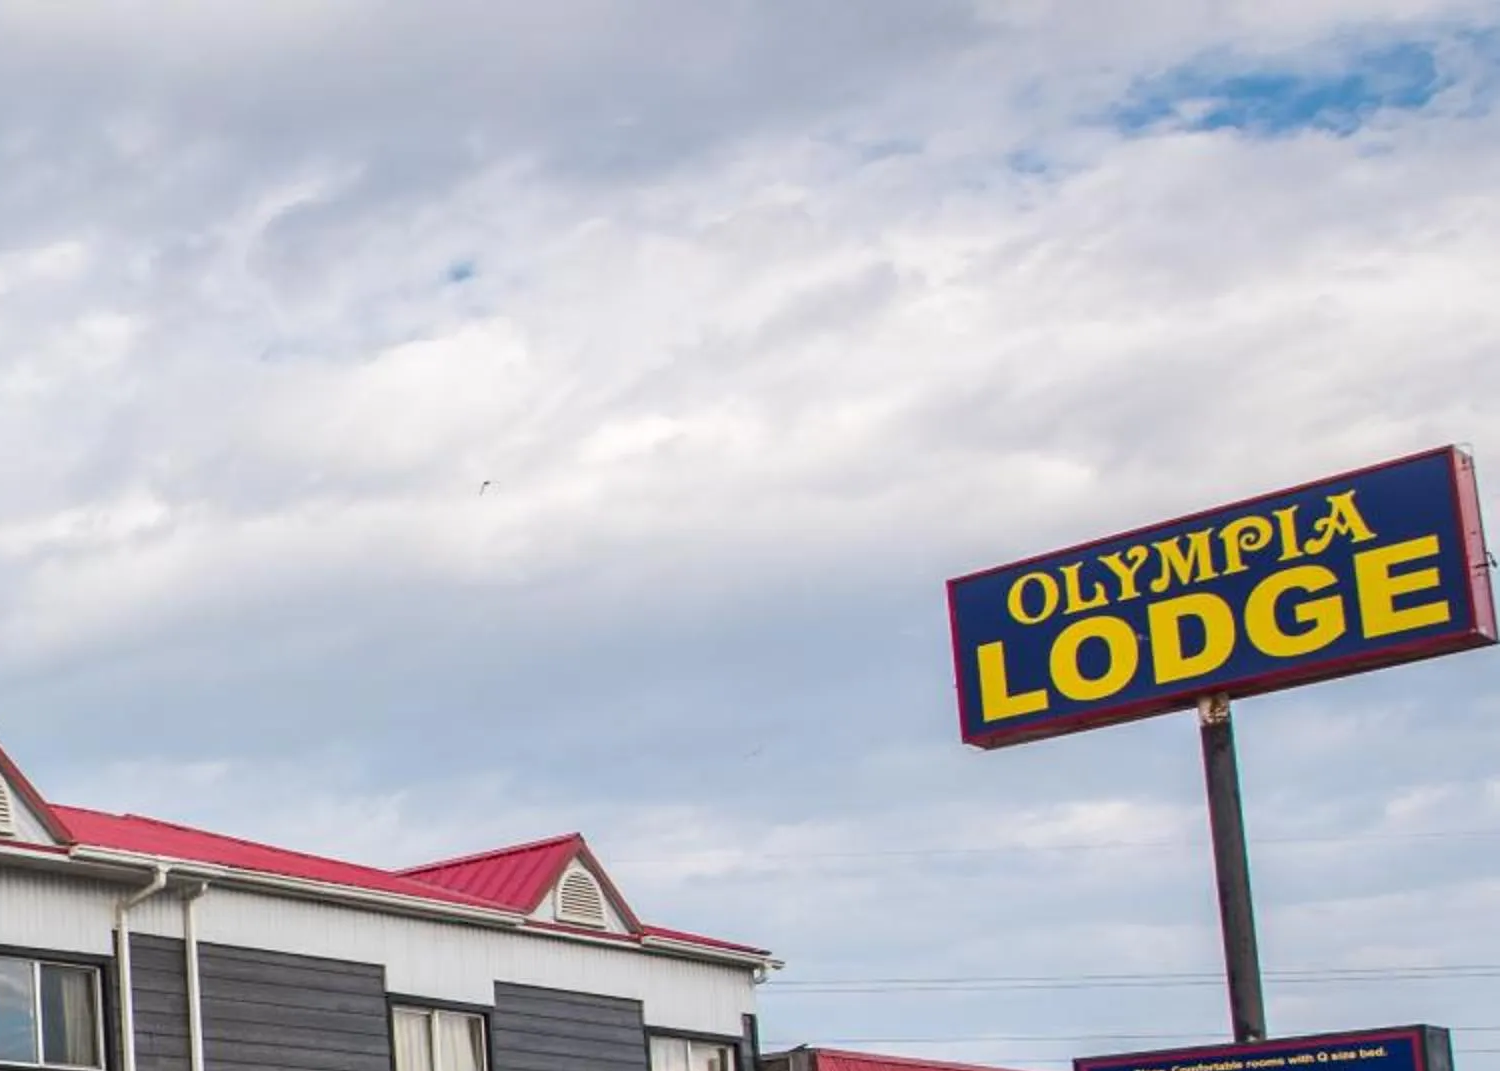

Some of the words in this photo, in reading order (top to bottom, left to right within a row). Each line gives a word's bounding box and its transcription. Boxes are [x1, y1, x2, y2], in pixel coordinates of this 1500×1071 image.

[1007, 490, 1376, 624] OLYMPIA
[977, 535, 1450, 722] LODGE
[1246, 1057, 1284, 1069] rooms
[1288, 1053, 1315, 1065] with
[1317, 1051, 1328, 1062] Q
